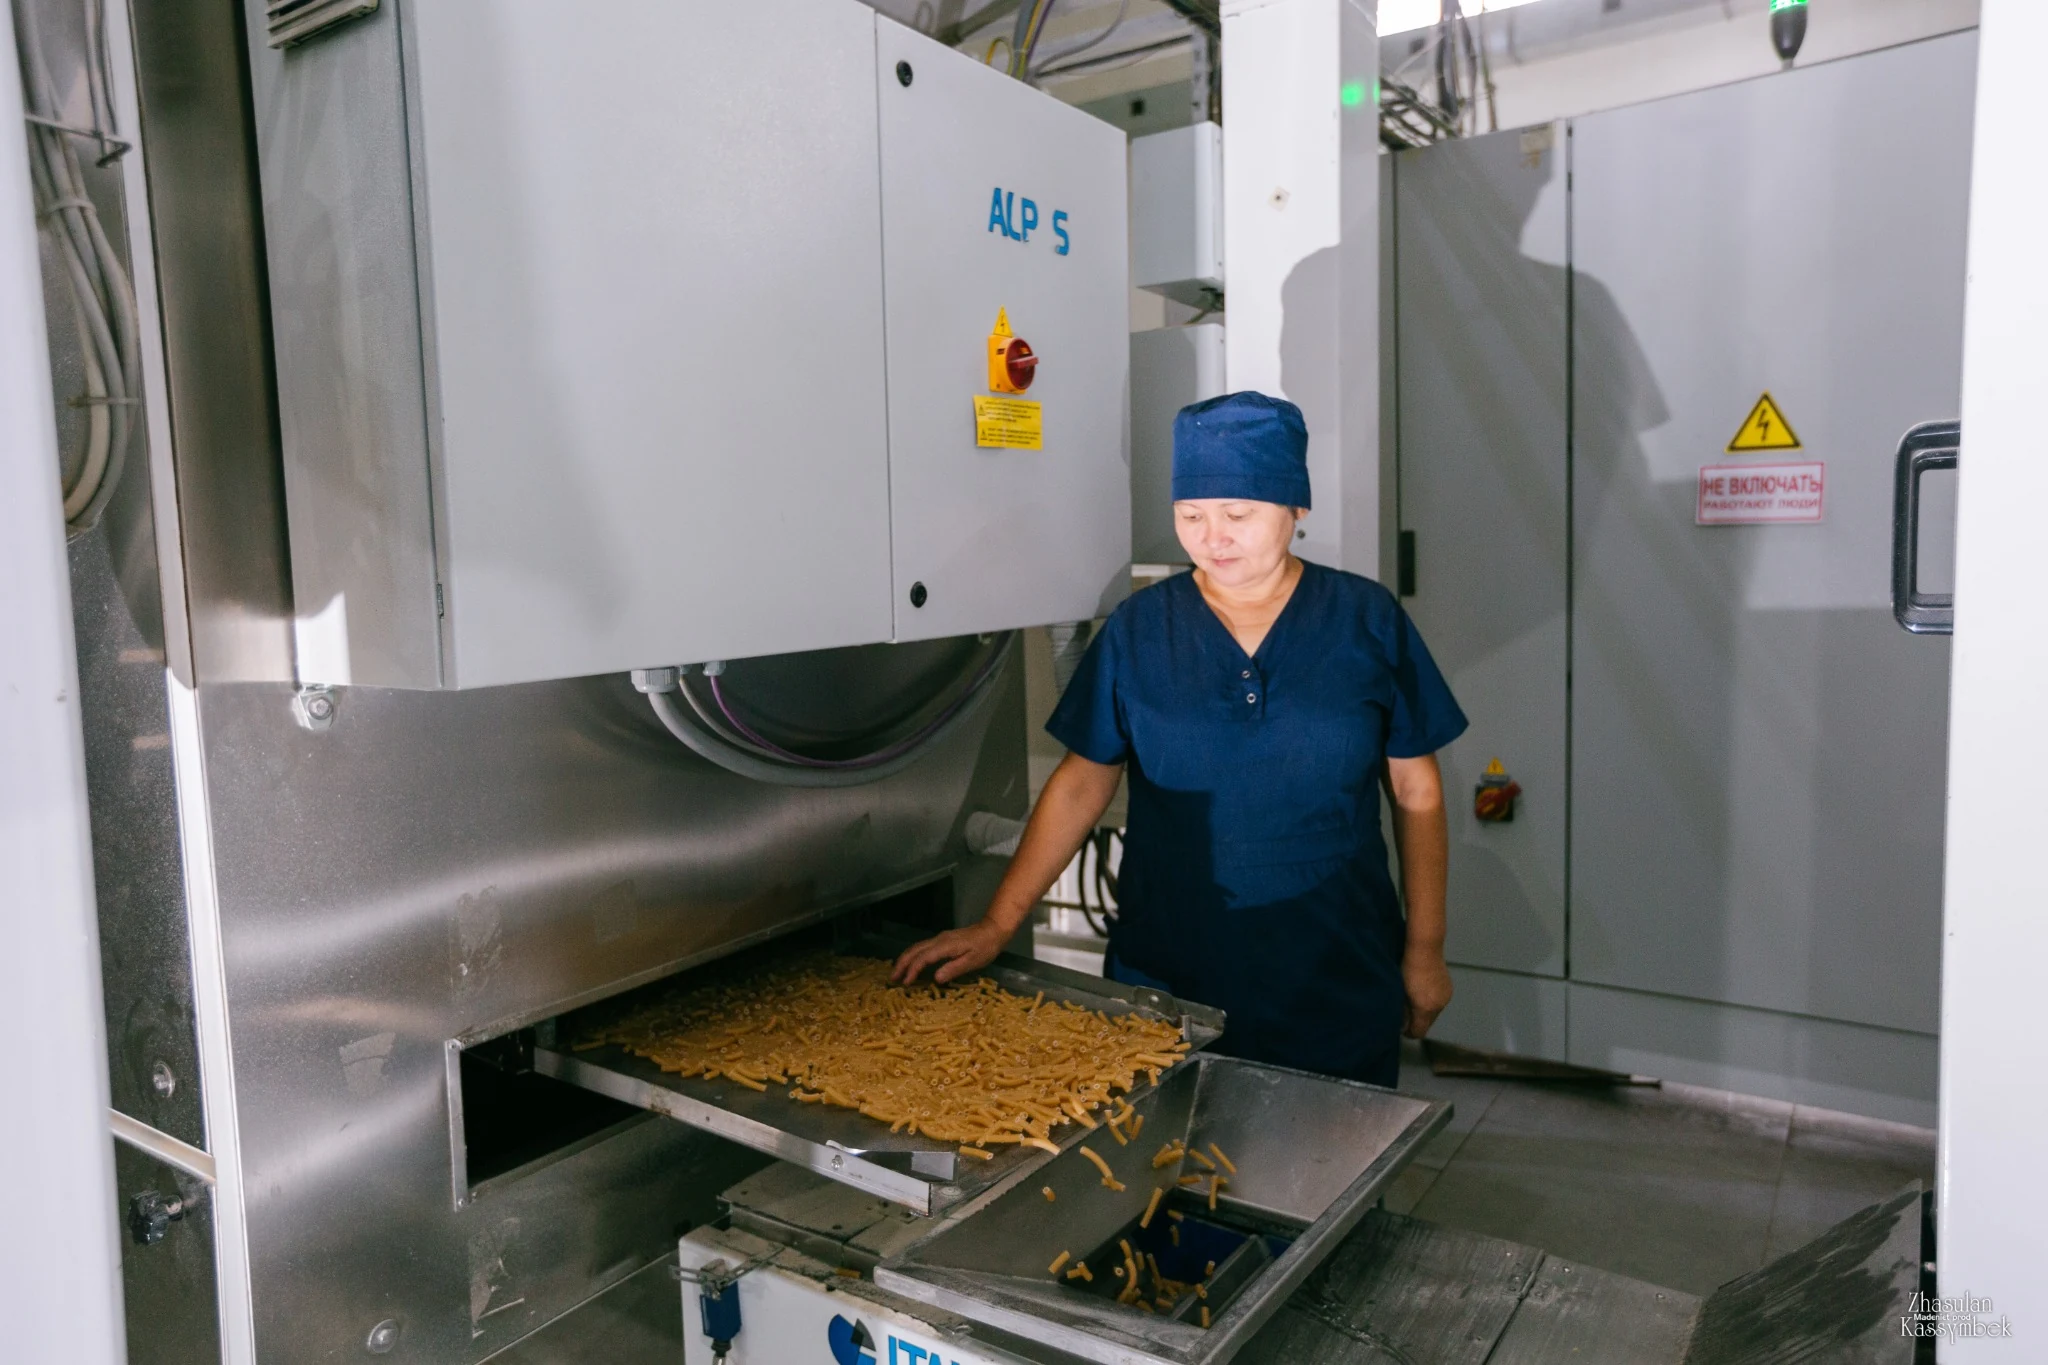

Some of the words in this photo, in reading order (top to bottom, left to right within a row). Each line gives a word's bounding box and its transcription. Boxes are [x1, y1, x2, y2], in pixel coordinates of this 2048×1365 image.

[988, 187, 1038, 242] ALP
[1053, 209, 1070, 256] S
[1703, 477, 1724, 496] НЕ
[1729, 474, 1820, 495] ВКЛЮЧАТЬ
[1703, 499, 1773, 510] РАБОТАЮТ
[1778, 498, 1818, 509] ЛЮДИ
